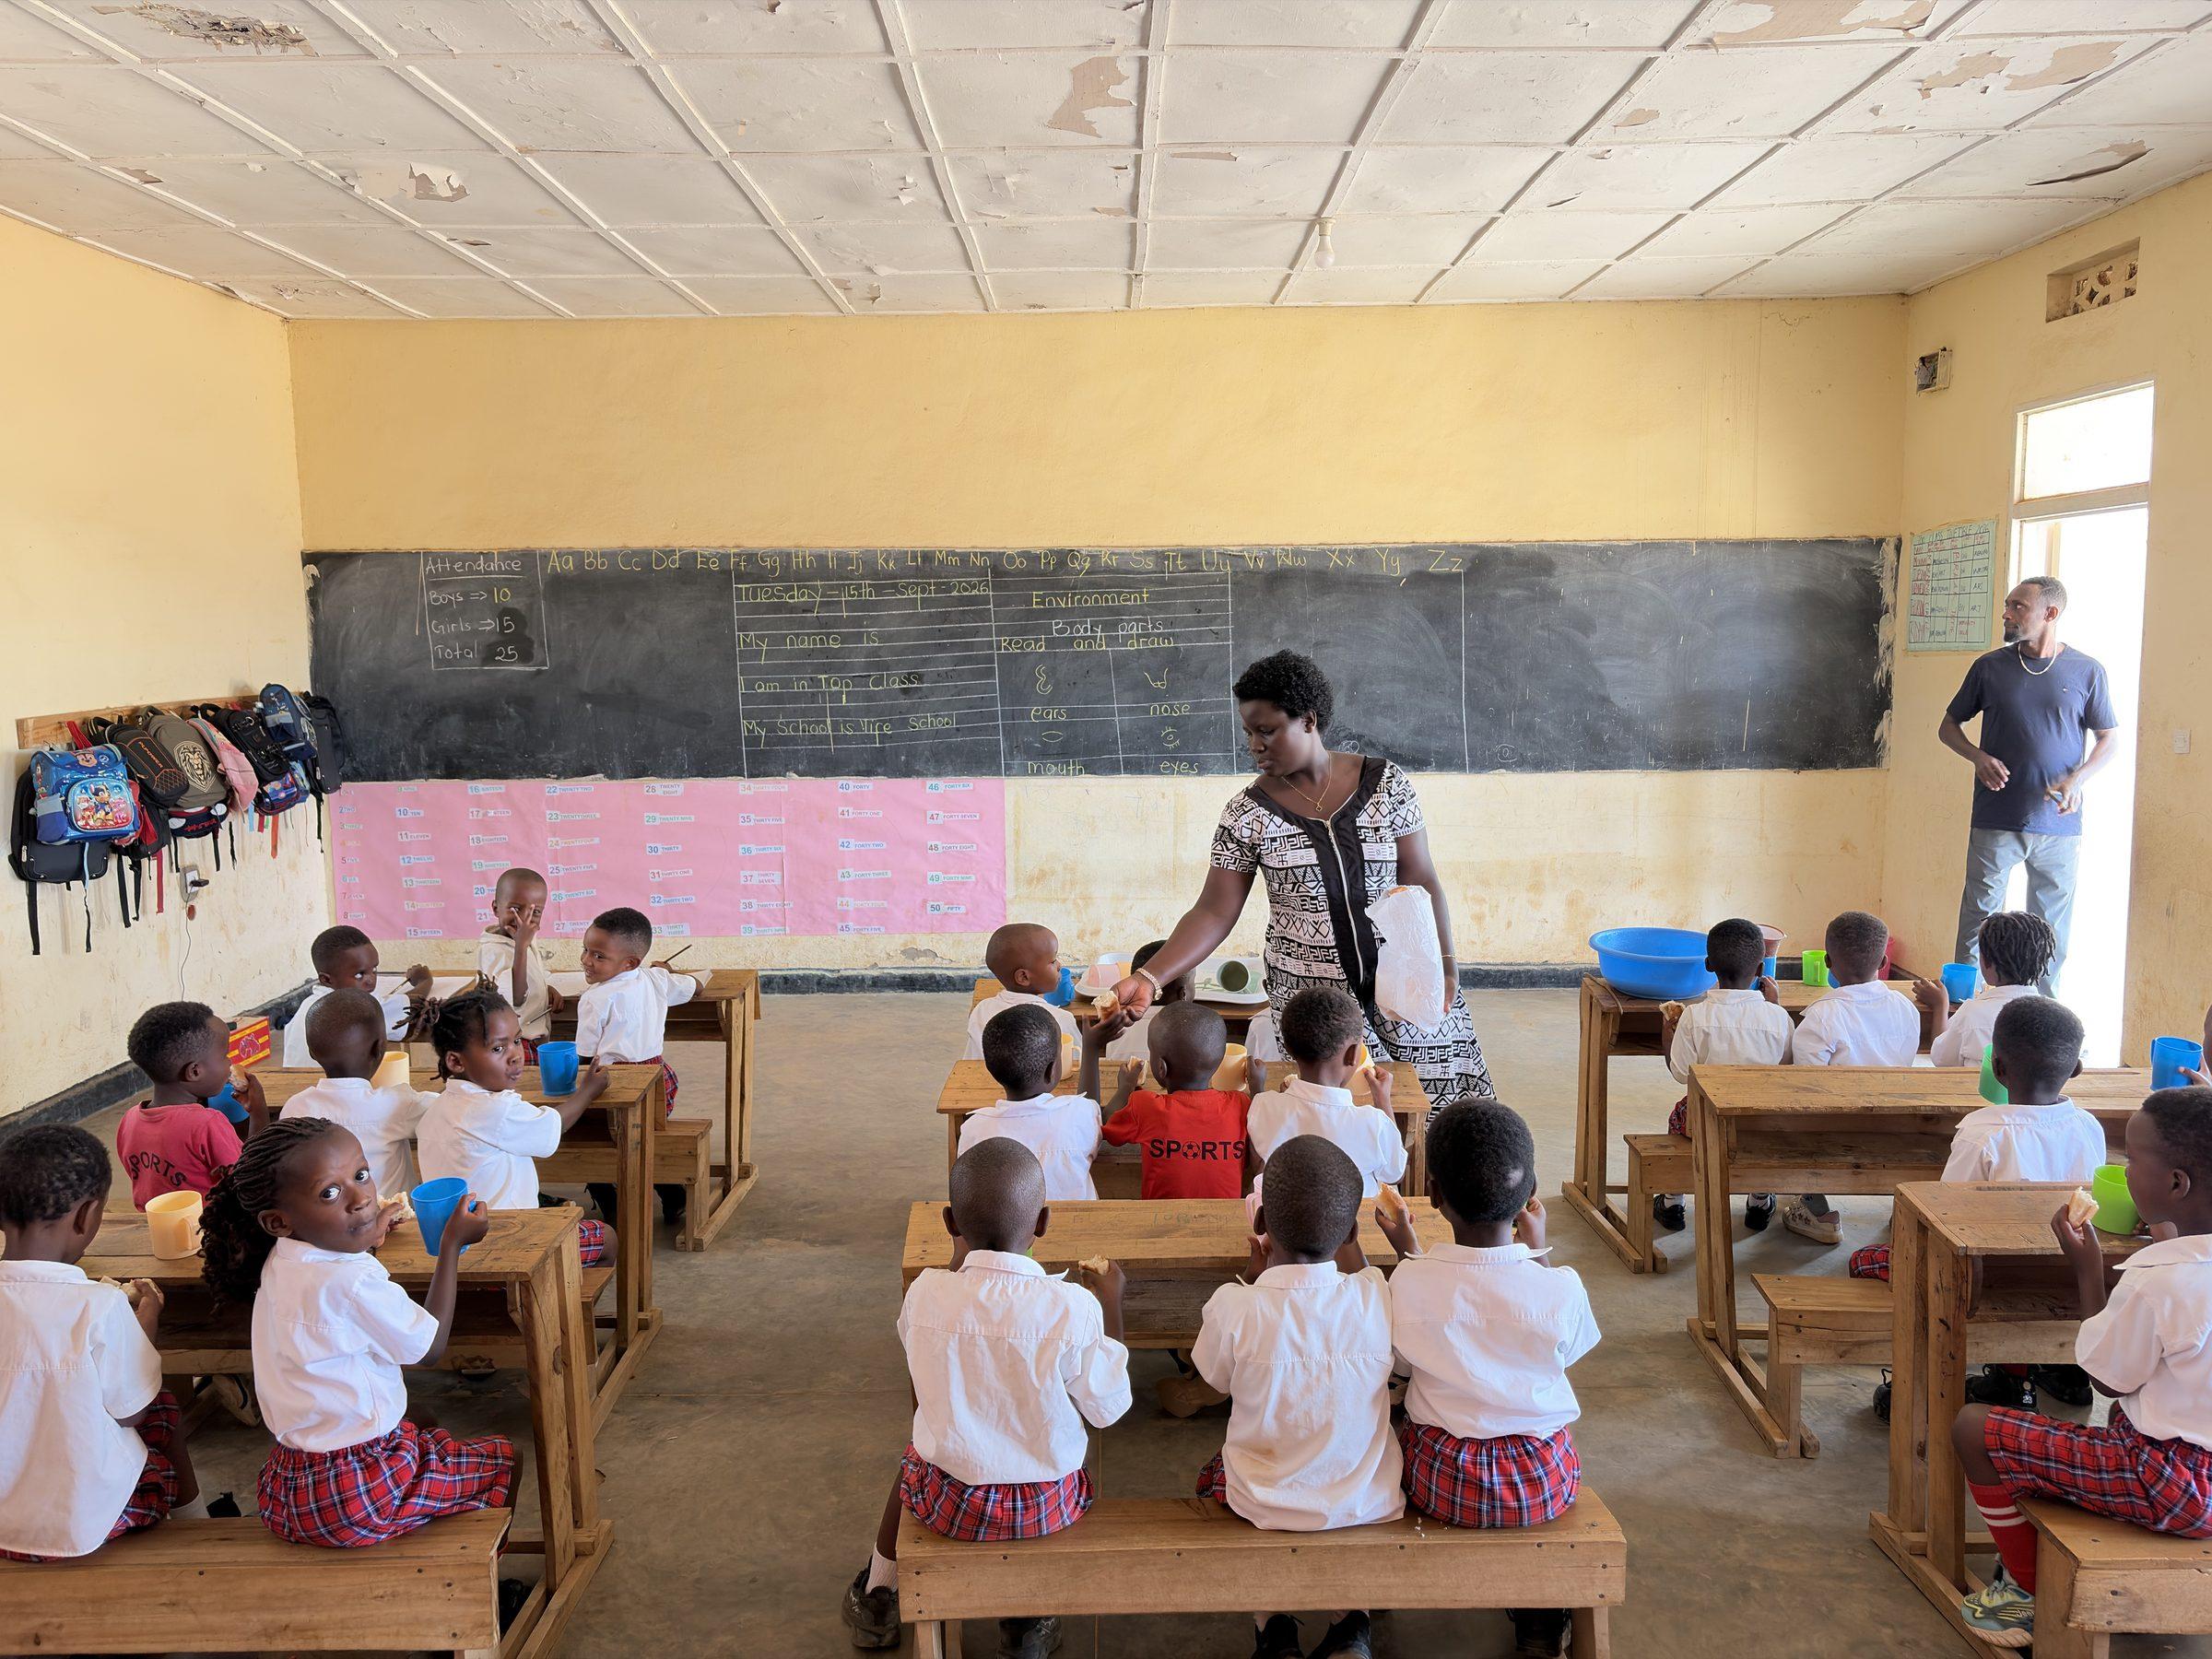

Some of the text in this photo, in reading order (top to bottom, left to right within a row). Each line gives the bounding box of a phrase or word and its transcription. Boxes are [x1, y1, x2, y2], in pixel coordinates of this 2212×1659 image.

[426, 557, 522, 573] Attendance
[548, 551, 572, 573] Aa
[584, 551, 608, 571] Bb
[618, 550, 641, 571] Cc
[653, 549, 679, 570] Dd
[697, 552, 719, 571] Ee
[730, 550, 747, 571] Ff
[759, 553, 780, 577] Gg
[793, 550, 816, 570] Hh
[848, 551, 862, 573] Jj
[878, 553, 896, 571] Kk
[935, 552, 960, 566] Mm
[970, 552, 989, 567] Nn
[1003, 551, 1026, 569] Oo
[1040, 552, 1056, 569] Pp
[1130, 552, 1153, 569] Ss
[1165, 552, 1186, 571] Tt
[1202, 552, 1230, 571] Uu
[1244, 552, 1265, 570] Vv
[1326, 550, 1356, 568] Xx
[1375, 548, 1400, 576] Yy
[1429, 549, 1463, 571] Zz
[429, 589, 511, 606] Boys 10
[737, 580, 821, 617] Tuesday
[896, 580, 935, 611] Sept
[950, 582, 988, 595] 2026
[1032, 588, 1149, 608] Environment
[432, 617, 515, 633] Girls 15
[1053, 616, 1163, 642] Body parts
[739, 633, 767, 664] My
[787, 634, 841, 648] name
[1001, 634, 1173, 652] Read and draw
[435, 646, 518, 662] Total 25
[740, 673, 918, 705] I am in Top Class
[1030, 704, 1189, 722] ears nose
[743, 720, 766, 748] My
[777, 718, 831, 735] School
[841, 721, 854, 735] is
[908, 712, 956, 731] School
[1029, 759, 1198, 775] mouth eyes
[128, 1151, 187, 1187] SPORTS
